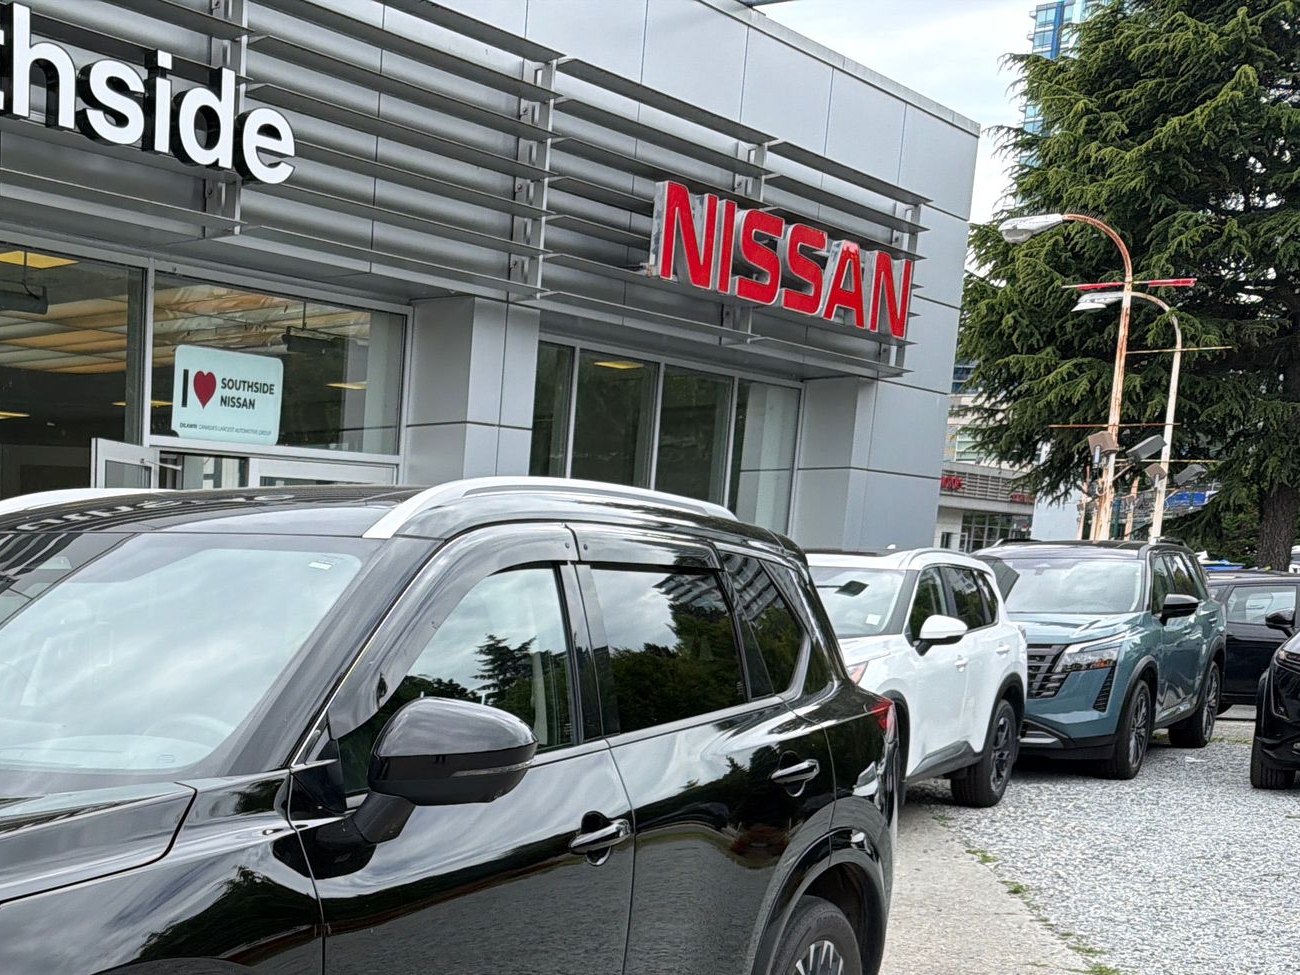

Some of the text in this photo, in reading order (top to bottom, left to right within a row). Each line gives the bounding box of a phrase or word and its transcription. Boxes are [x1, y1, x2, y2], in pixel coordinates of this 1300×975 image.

[658, 180, 913, 339] NISSAN
[181, 369, 190, 408] I
[220, 377, 275, 395] SOUTHSIDE
[220, 395, 256, 410] NISSAN
